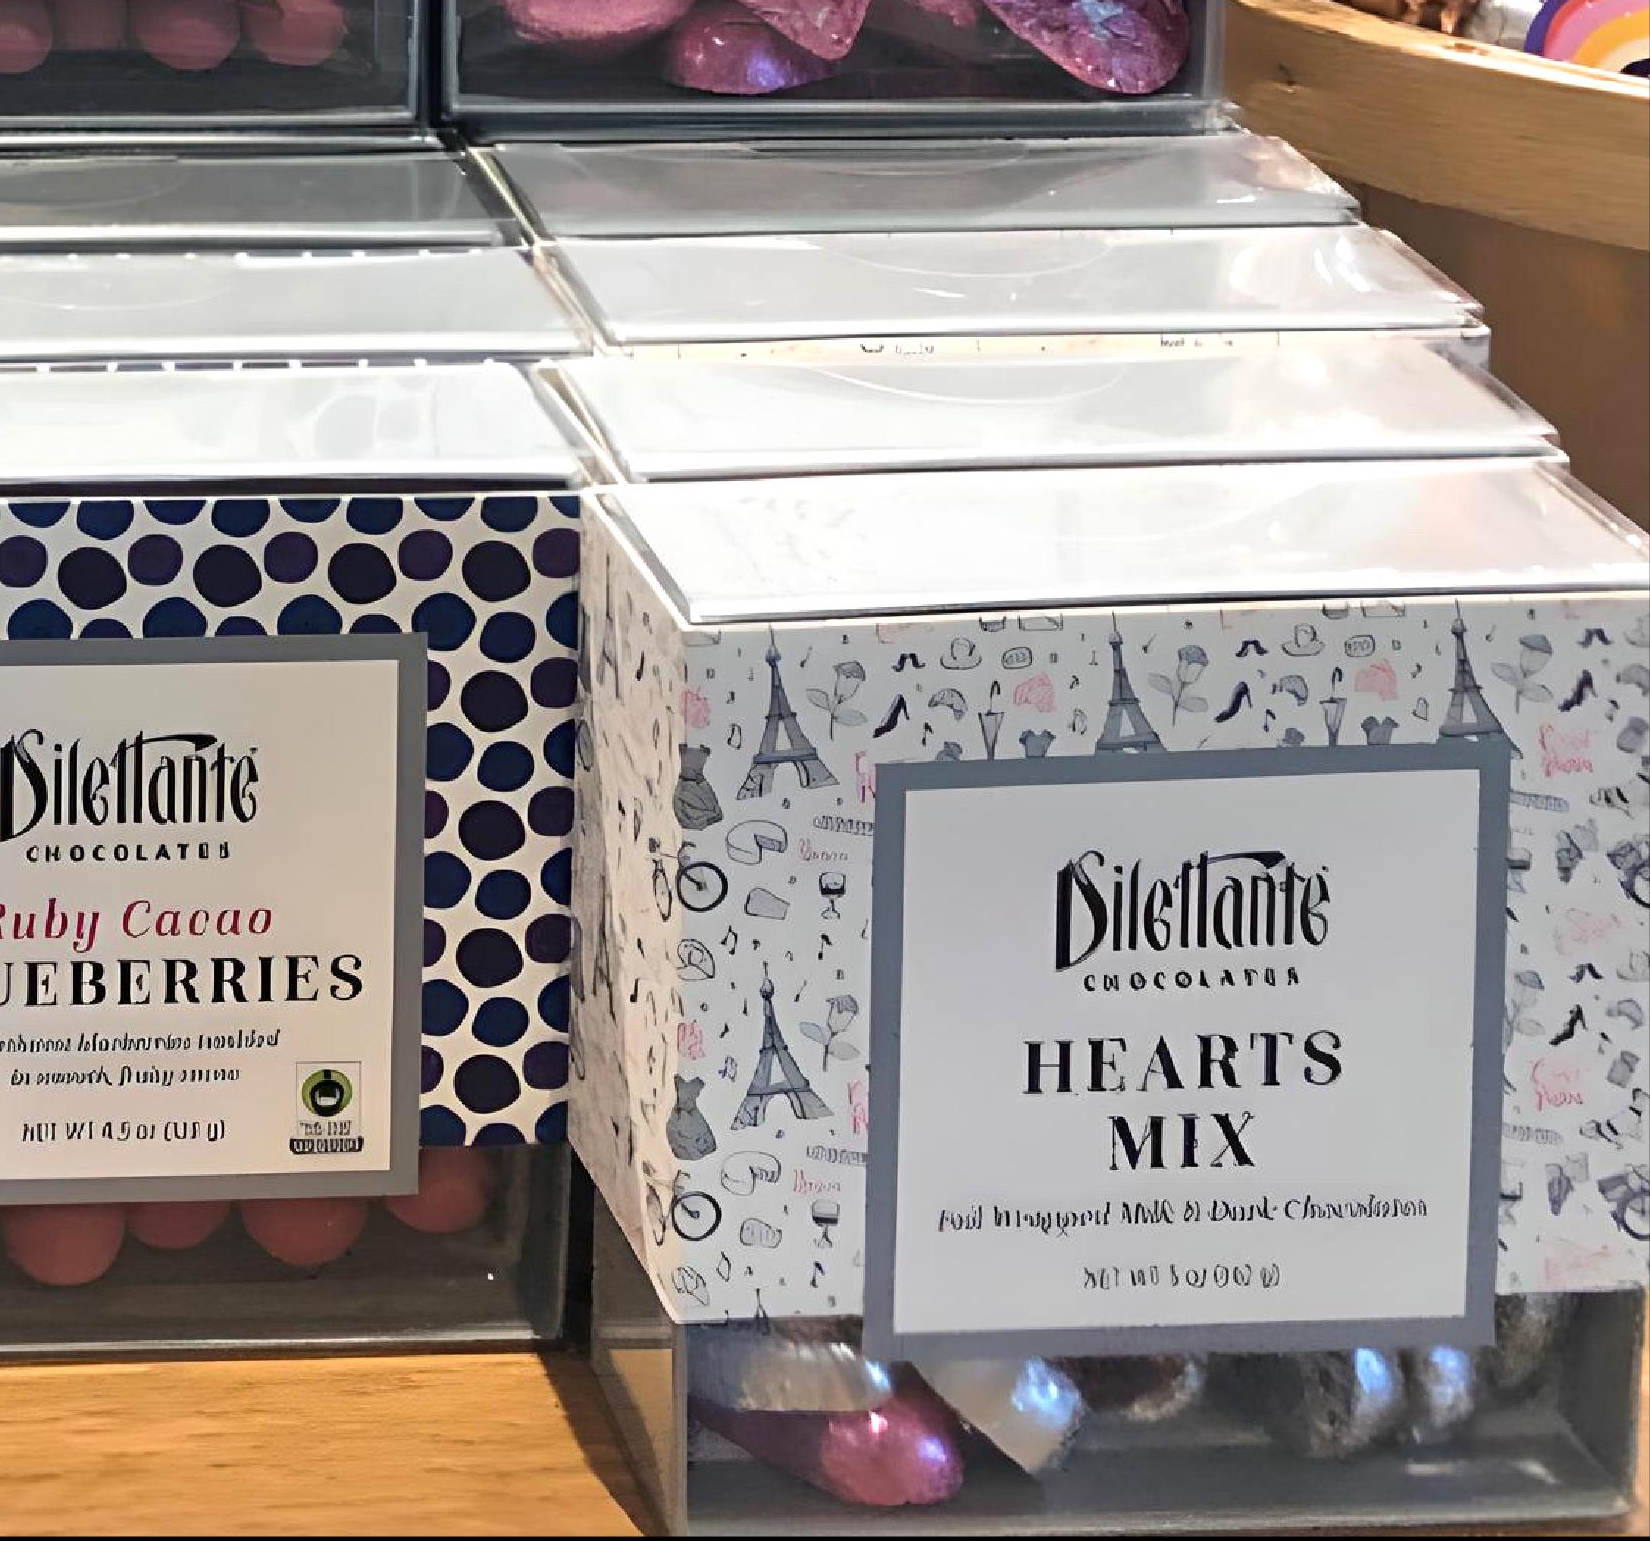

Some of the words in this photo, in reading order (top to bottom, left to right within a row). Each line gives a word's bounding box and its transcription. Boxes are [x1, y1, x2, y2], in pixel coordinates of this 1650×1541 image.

[122, 899, 275, 939] Cacao
[1023, 1029, 1343, 1095] HEARTS
[1108, 1111, 1255, 1170] MIX
